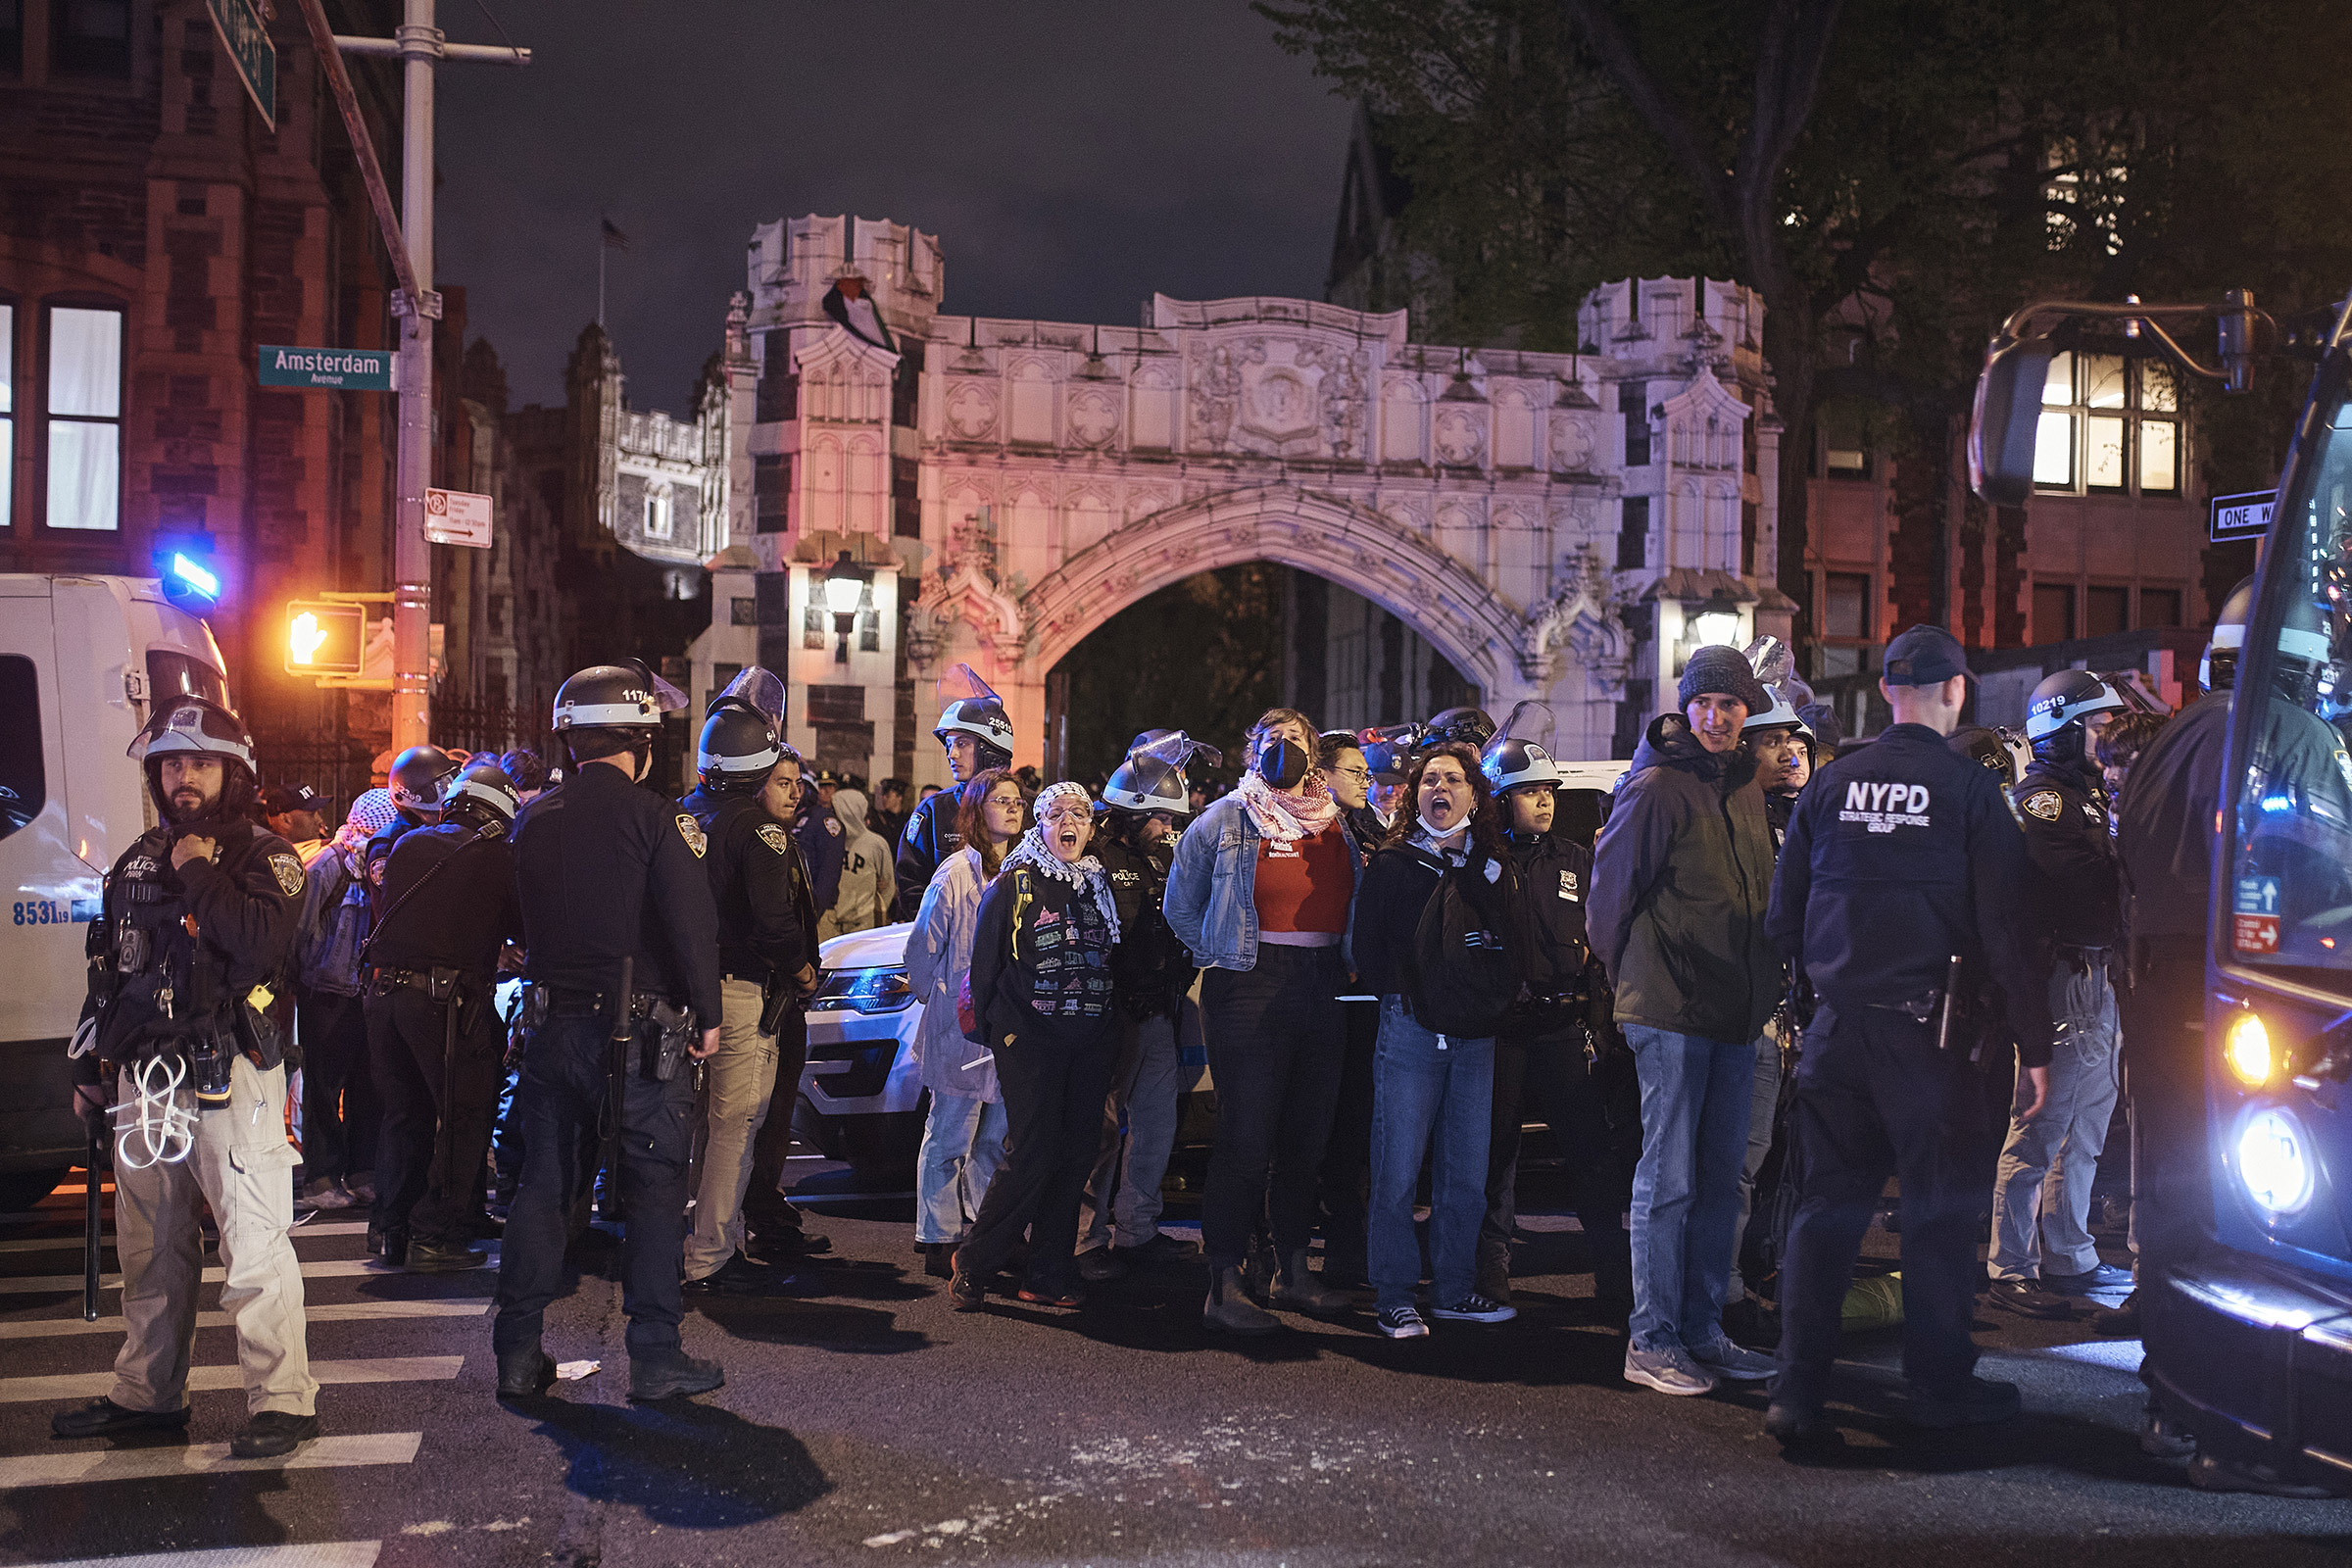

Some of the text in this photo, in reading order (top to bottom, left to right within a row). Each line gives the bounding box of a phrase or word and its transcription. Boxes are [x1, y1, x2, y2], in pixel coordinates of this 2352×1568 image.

[275, 350, 379, 374] Amsterdam
[311, 373, 344, 385] Avenue
[2225, 508, 2250, 525] ONE
[2032, 695, 2066, 715] 10219
[1845, 781, 1930, 814] NYPD
[1838, 810, 1931, 827] STRATEGIC RESPONSE
[1867, 822, 1896, 833] GROUP
[122, 858, 160, 872] POLICE
[842, 851, 865, 874] AP
[1111, 871, 1140, 881] POLICE
[13, 901, 69, 925] 8531 19
